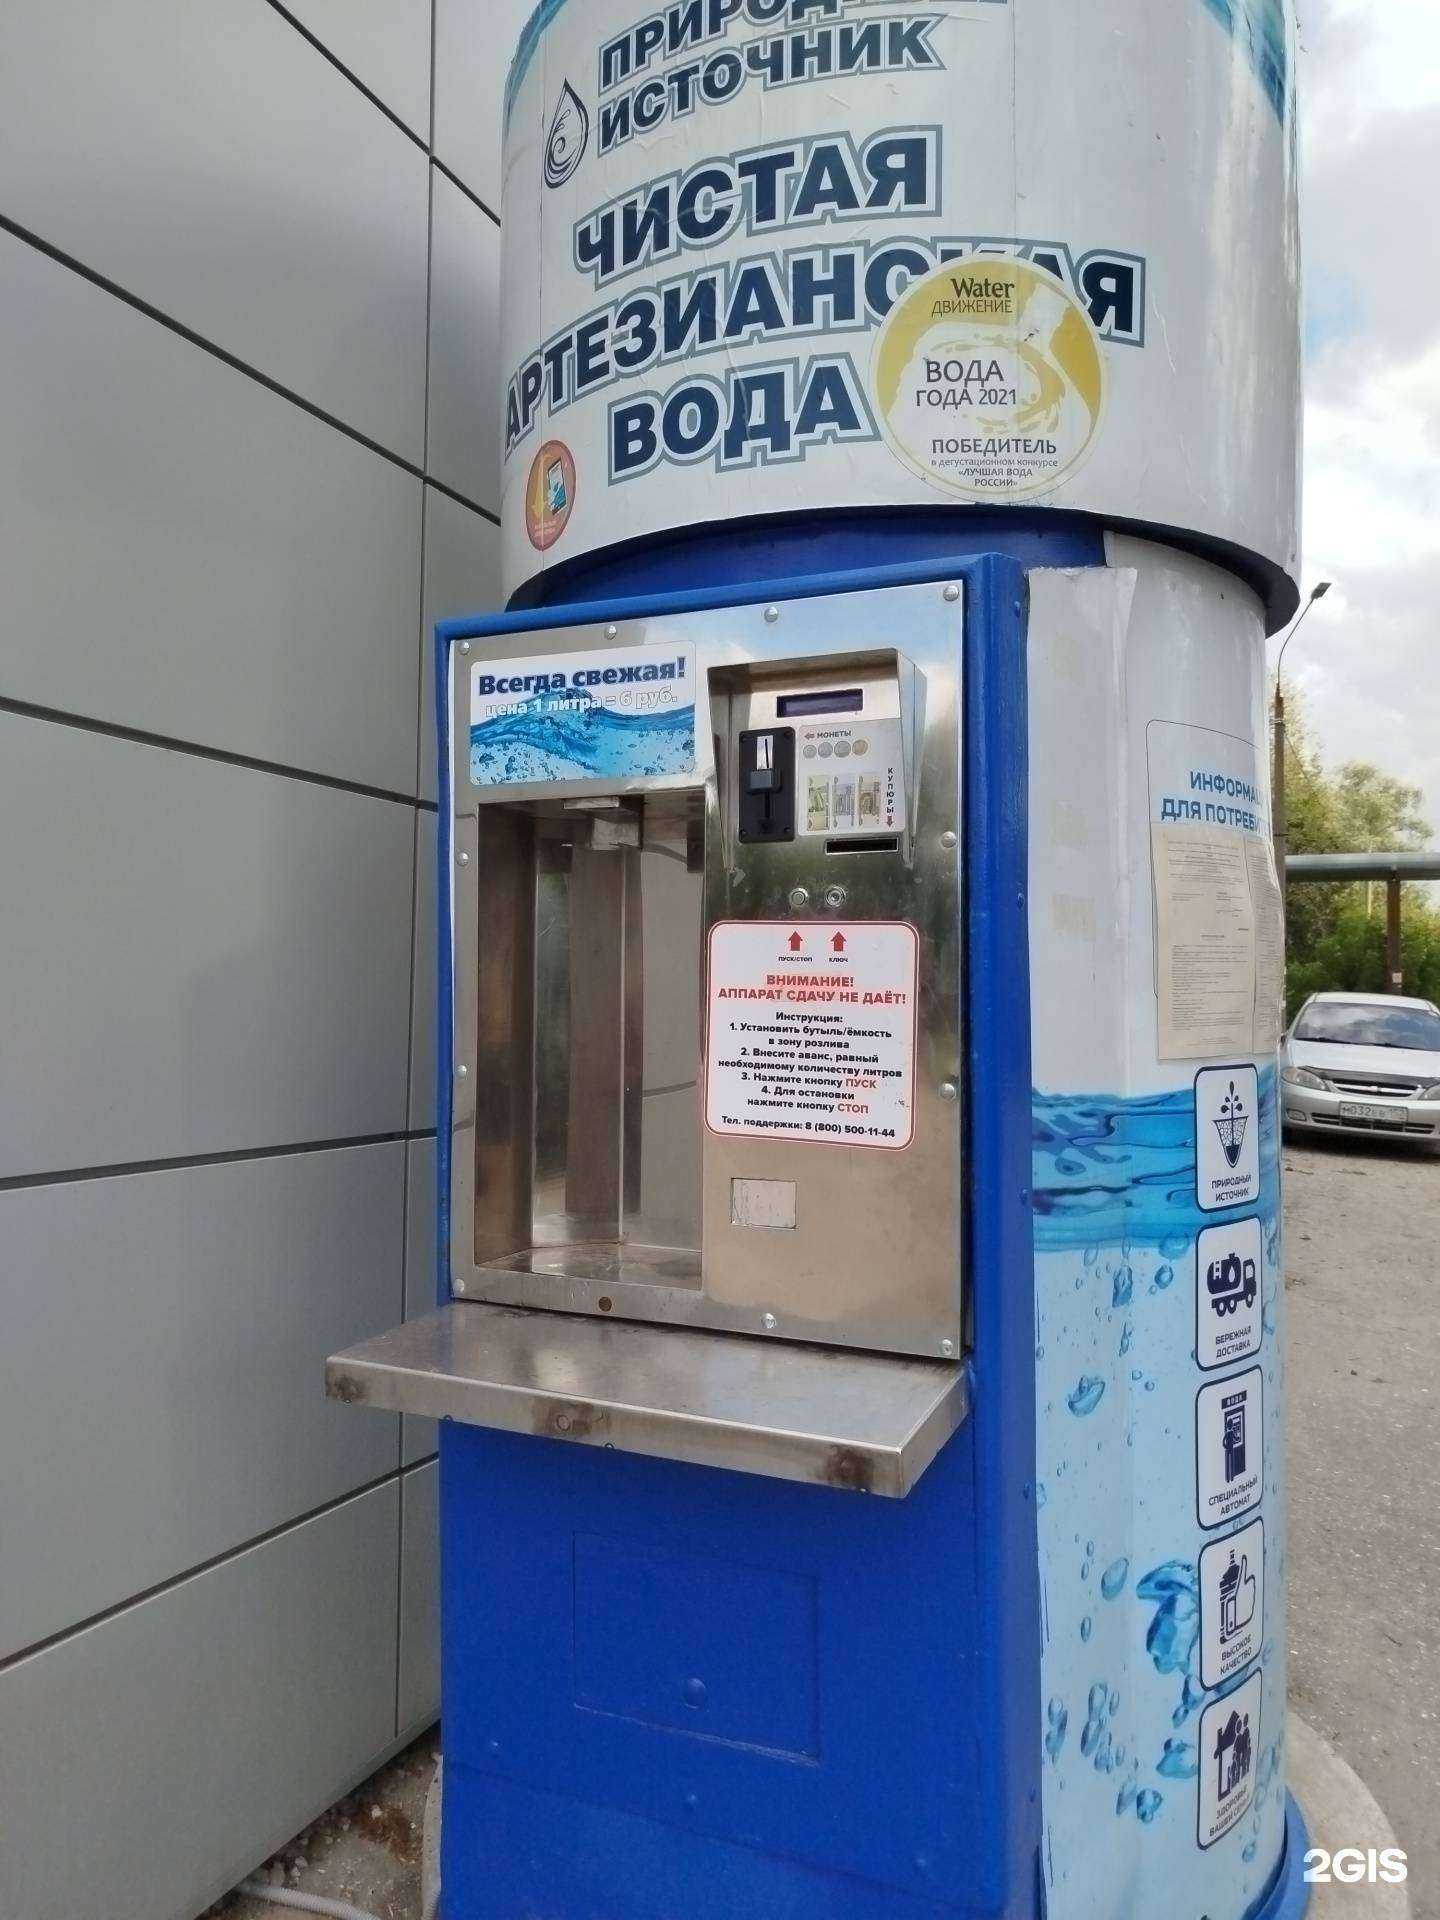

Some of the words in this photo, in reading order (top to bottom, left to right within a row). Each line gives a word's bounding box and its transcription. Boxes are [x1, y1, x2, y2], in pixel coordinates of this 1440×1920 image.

[599, 19, 937, 150] ИСТОЧНИК
[575, 135, 929, 279] ЧИСТАЯ
[950, 277, 1015, 299] Water
[931, 299, 1013, 317] ДВИЖЕНИЕ
[505, 245, 1134, 448] АРТЕЗИАНСЯ
[925, 359, 1005, 388] ВОДА
[916, 389, 973, 410] ГОДА
[978, 388, 1017, 405] 2021
[612, 365, 863, 474] ВОДА
[931, 438, 1058, 457] ПОБЕДИТЕЛЬ
[938, 458, 1015, 468] дегустационном
[1017, 459, 1058, 469] конкурсе
[958, 468, 1005, 476] «ЛУЧШАЯ
[1006, 468, 1033, 478] ВОДА
[974, 478, 1018, 487] РОССИИ»
[478, 672, 566, 696] Всегда
[571, 656, 687, 688] свежая!
[485, 702, 528, 718] цена
[533, 698, 543, 713] 1
[618, 690, 633, 707] 6
[635, 685, 678, 710] руб.
[816, 730, 851, 739] МОНЕТЫ
[886, 767, 895, 814] КУПЮРЫ
[1160, 798, 1202, 822] ДЛЯ
[778, 955, 813, 963] ПУСК/СТОП
[766, 974, 854, 988] ВНИМАНИЕ!
[718, 988, 783, 1001] АППАРАТ
[786, 989, 836, 1003] СДАЧУ
[839, 991, 859, 1003] НЕ
[862, 991, 906, 1005] ДАЁТ!
[775, 1011, 843, 1023] Инструкция:
[729, 1022, 738, 1031] 1.
[739, 1022, 800, 1034] Установить
[802, 1025, 892, 1039] бутыль/ёмкость
[777, 1038, 802, 1048] зону
[804, 1039, 850, 1050] розлива
[740, 1047, 750, 1056] 2.
[752, 1047, 796, 1059] Внесите
[798, 1052, 833, 1062] аванс,
[835, 1053, 879, 1064] равный
[718, 1059, 795, 1073] необходимому
[797, 1064, 860, 1077] количеству
[862, 1067, 903, 1078] литров
[741, 1071, 751, 1081] 3.
[753, 1073, 802, 1084] Нажмите
[804, 1076, 843, 1088] кнопку
[845, 1078, 878, 1089] ПУСК
[761, 1085, 771, 1095] 4.
[773, 1086, 796, 1097] Для
[798, 1089, 855, 1101] остановки
[747, 1098, 794, 1108] нажмите
[796, 1100, 835, 1112] кнопку
[837, 1103, 869, 1114] СТОП
[721, 1115, 742, 1126] Тел.
[743, 1118, 803, 1130] поддержки:
[804, 1121, 812, 1130] 8
[814, 1122, 842, 1134] (800)
[844, 1125, 896, 1138] 500-11-44
[1215, 1188, 1249, 1202] ИСТОЧНИК
[1215, 1339, 1251, 1358] ДОСТАВКА
[1220, 1493, 1252, 1515] АВТОМАТ
[1220, 1646, 1253, 1675] КАЧЕСТВО
